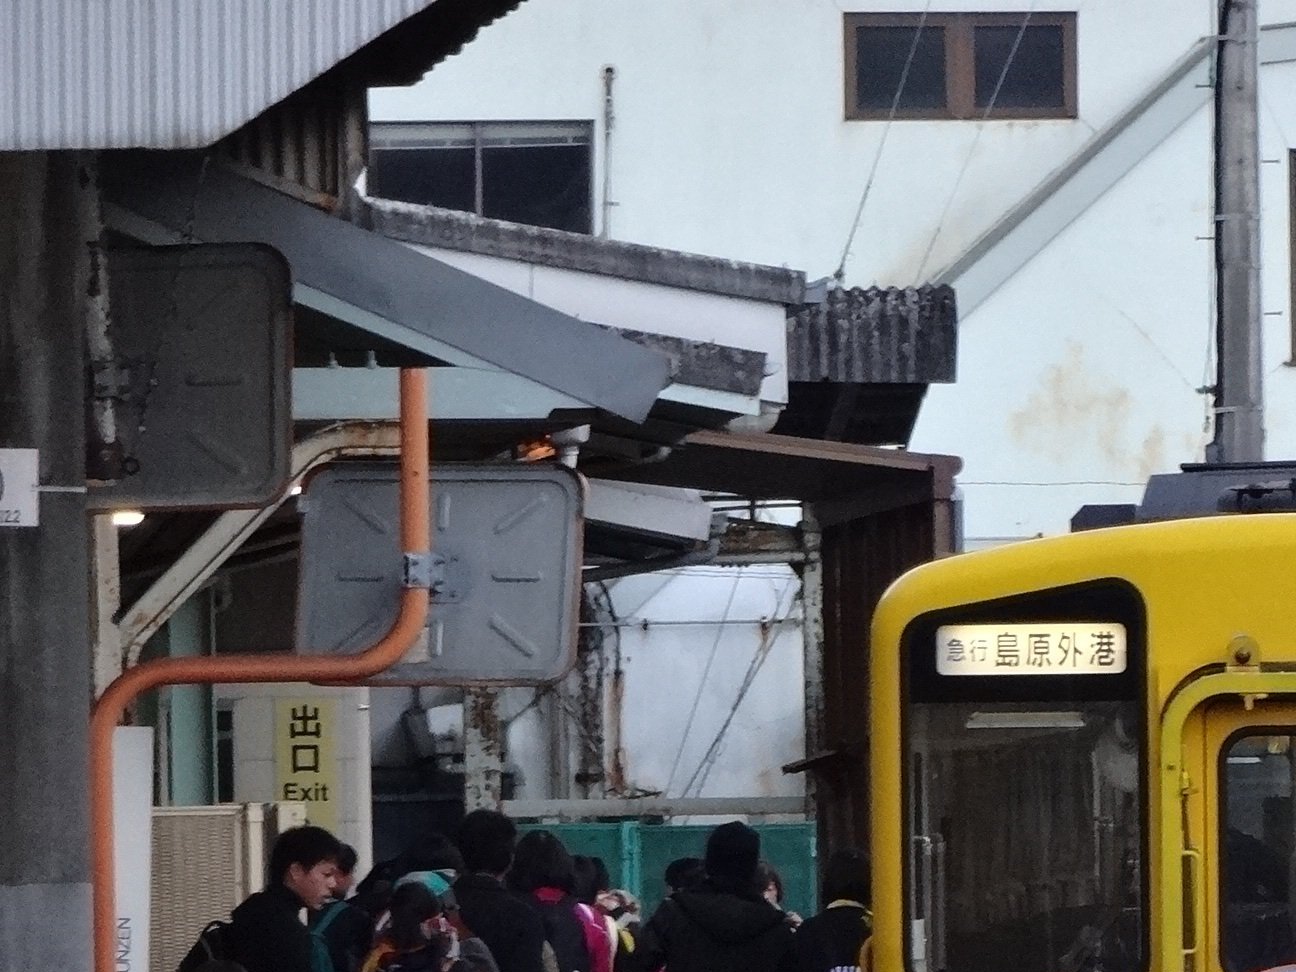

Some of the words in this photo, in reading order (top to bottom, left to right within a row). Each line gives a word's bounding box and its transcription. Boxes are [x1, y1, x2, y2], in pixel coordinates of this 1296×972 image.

[946, 638, 988, 662] 急行
[995, 631, 1115, 667] 島原外港
[290, 704, 321, 773] 出口
[283, 783, 328, 801] Exit
[116, 917, 131, 972] UNZEN
